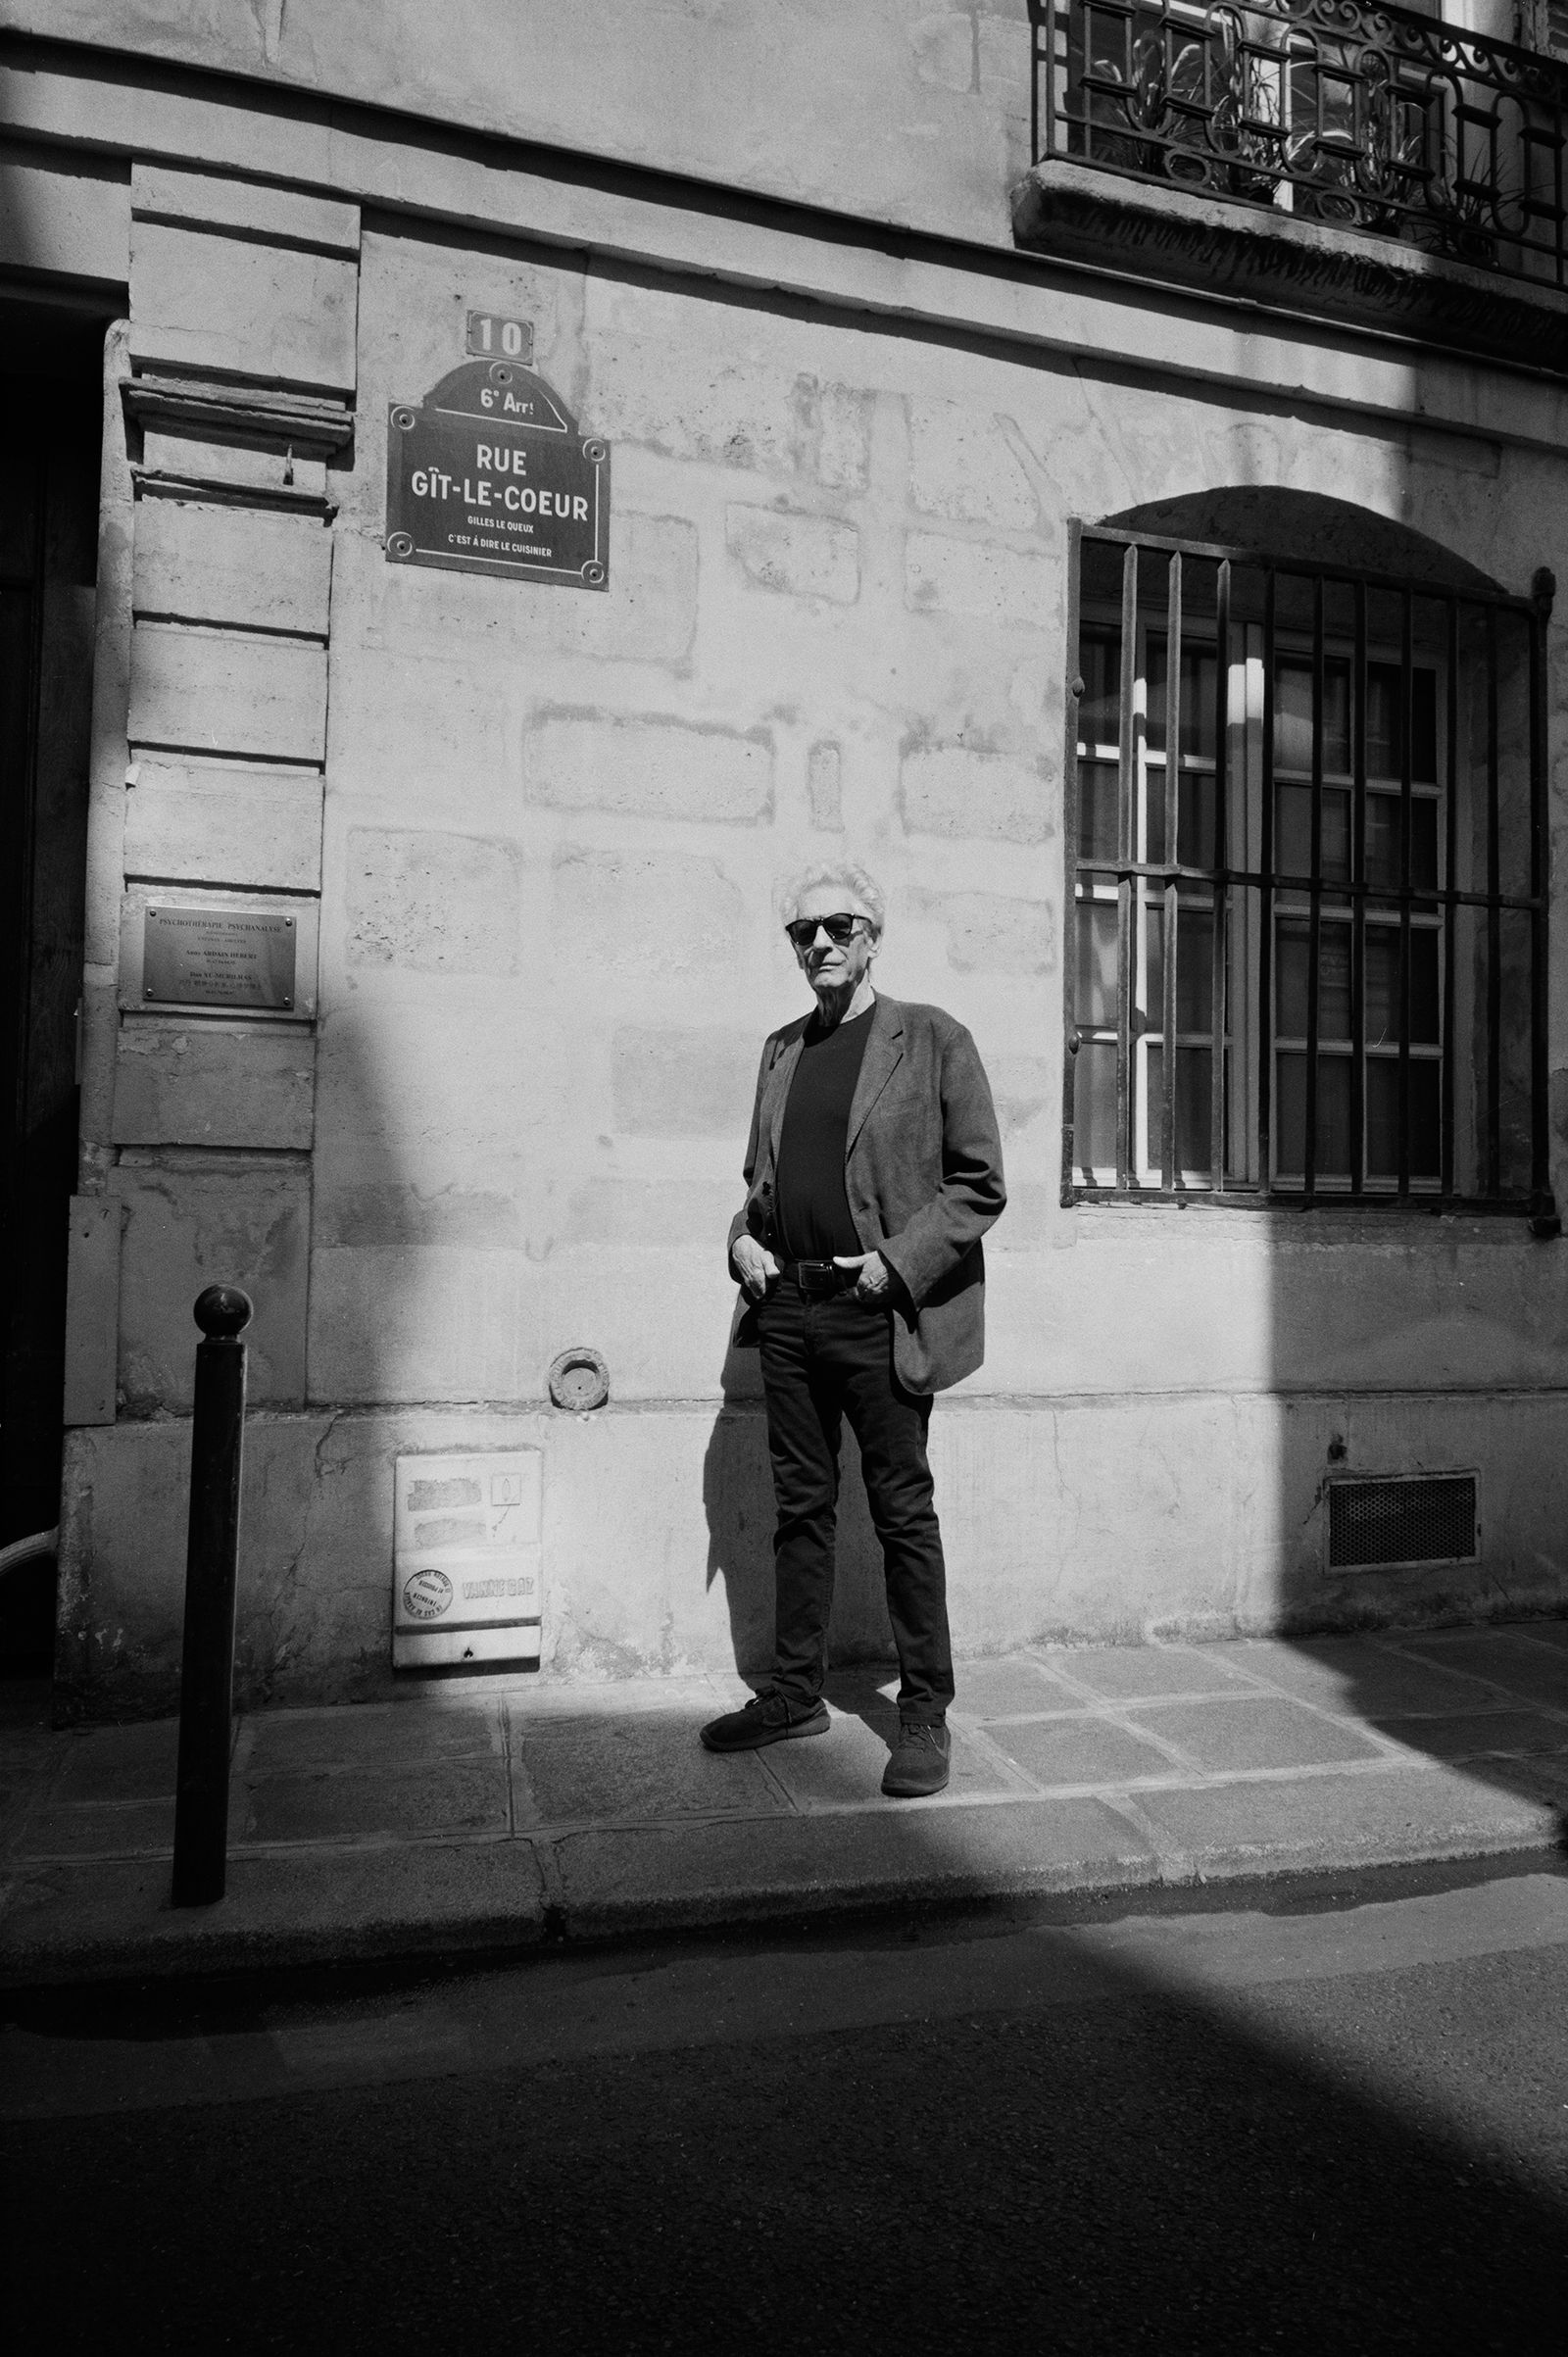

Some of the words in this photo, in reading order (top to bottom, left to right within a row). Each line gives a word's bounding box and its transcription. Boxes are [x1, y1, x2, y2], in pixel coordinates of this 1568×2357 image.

[480, 319, 521, 356] 10
[476, 444, 527, 475] RUE
[412, 466, 588, 521] GÎT-LE-COEUR
[467, 516, 495, 527] GILLES
[496, 519, 506, 529] LE
[507, 521, 534, 533] QUEUX
[448, 533, 471, 545] C'EST
[480, 538, 500, 550] DIRE
[501, 541, 511, 551] LE
[512, 543, 552, 558] CUISINIER
[463, 1579, 504, 1599] VANNE
[505, 1577, 534, 1597] GAZ
